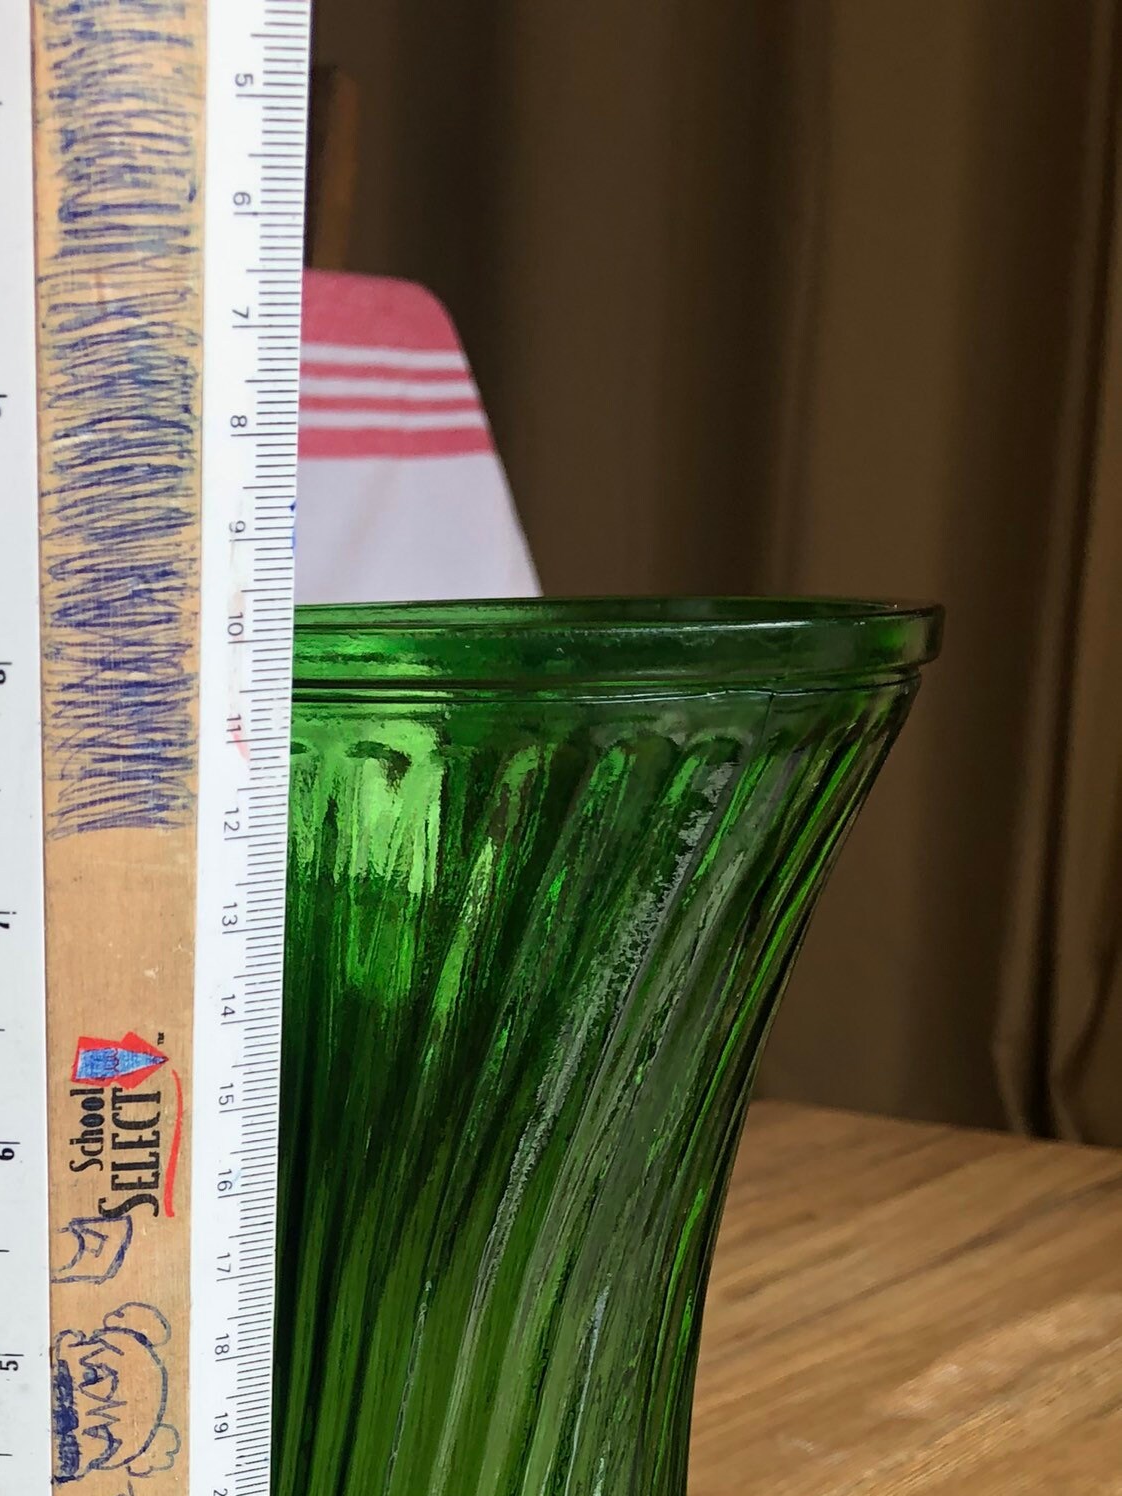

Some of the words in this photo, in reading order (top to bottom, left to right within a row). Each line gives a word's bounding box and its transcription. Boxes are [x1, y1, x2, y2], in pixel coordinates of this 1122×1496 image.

[235, 73, 254, 86] 5
[233, 192, 251, 206] 6
[232, 306, 250, 319] 7
[230, 415, 248, 428] 8
[229, 520, 246, 534] 9
[227, 612, 244, 636] 10
[226, 714, 242, 732] 11
[223, 808, 240, 832] 12
[221, 902, 238, 927] 13
[220, 995, 236, 1018] 14
[218, 1084, 234, 1106] 15
[69, 1087, 106, 1173] School
[98, 1087, 162, 1218] SELECT
[217, 1169, 232, 1191] 16
[216, 1252, 231, 1273] 17
[214, 1333, 230, 1355] 18
[0, 1359, 19, 1372] 5
[213, 1412, 229, 1433] 19
